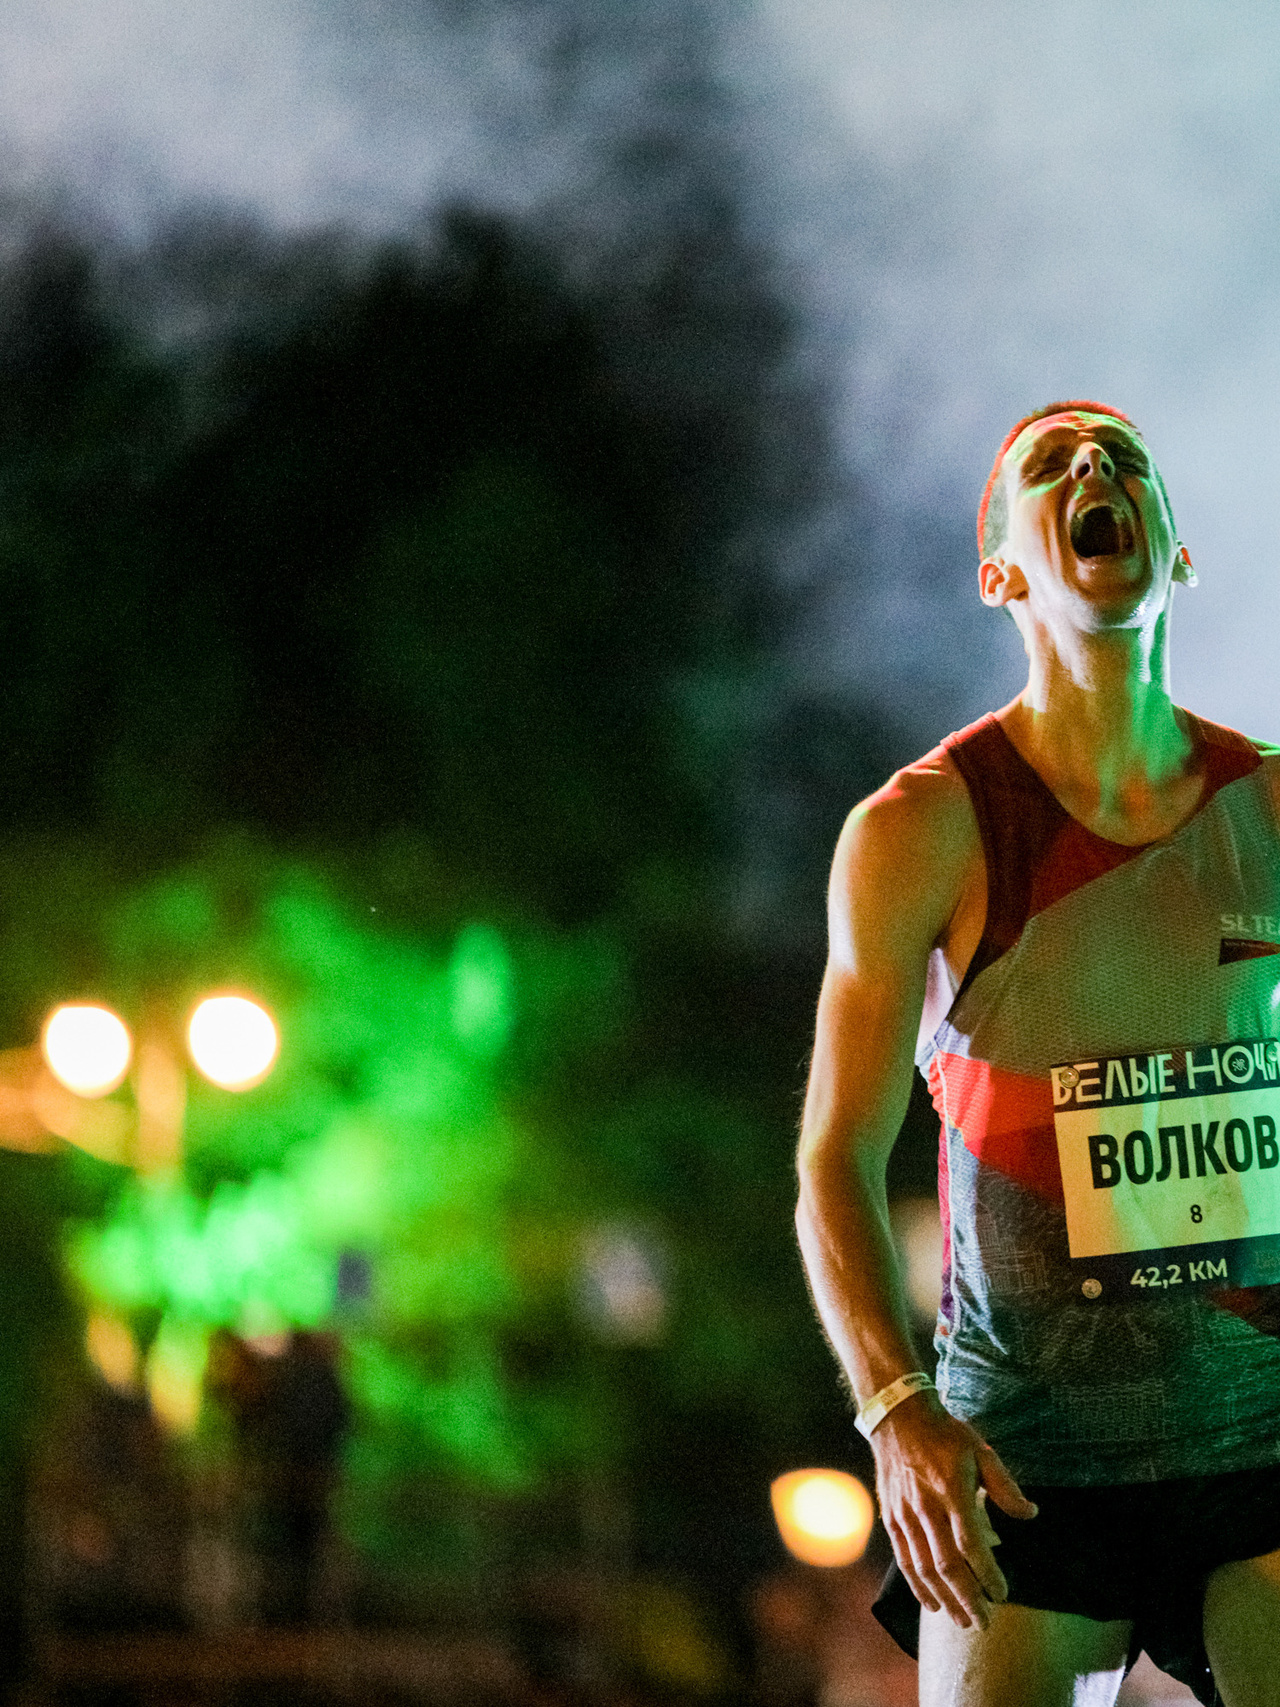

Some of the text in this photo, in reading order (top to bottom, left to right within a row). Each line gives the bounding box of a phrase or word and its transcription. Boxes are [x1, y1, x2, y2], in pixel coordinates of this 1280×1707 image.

[1088, 1115, 1280, 1190] ВОЛКОВ
[1190, 1204, 1203, 1224] 8
[1130, 1264, 1183, 1290] 42,2
[1189, 1258, 1228, 1281] КМ
